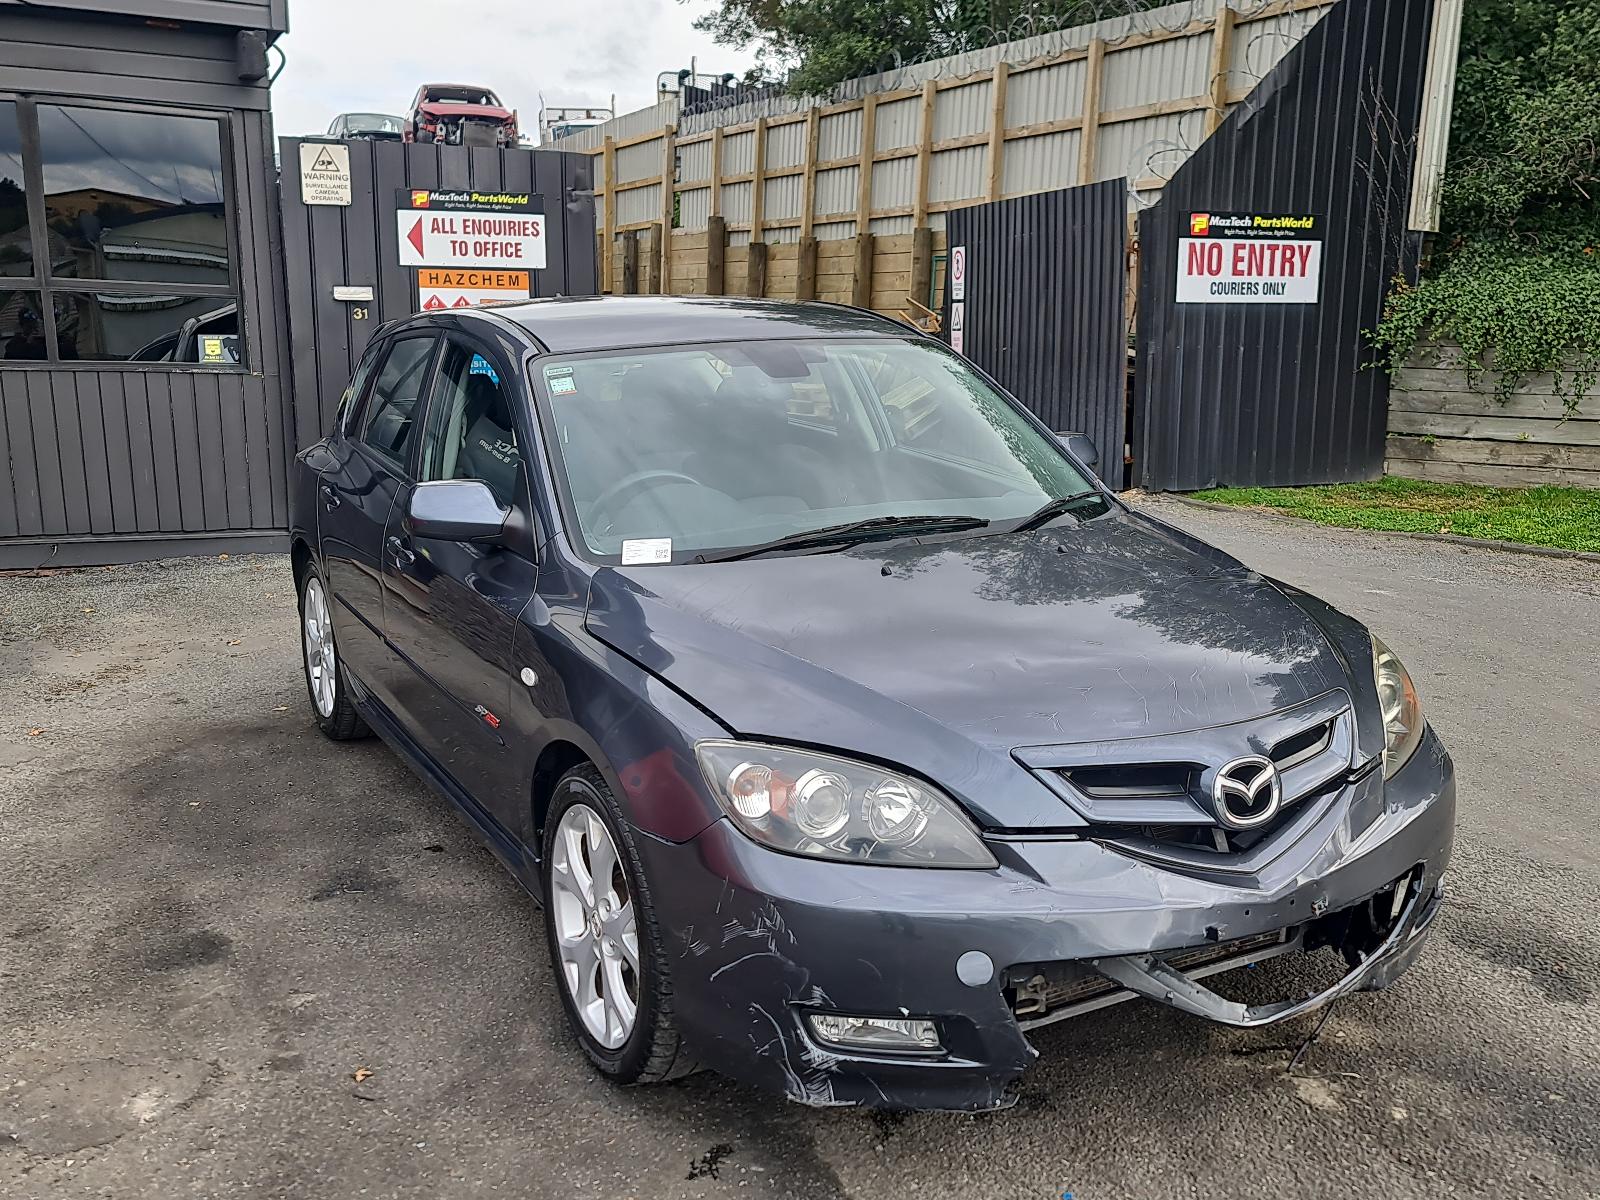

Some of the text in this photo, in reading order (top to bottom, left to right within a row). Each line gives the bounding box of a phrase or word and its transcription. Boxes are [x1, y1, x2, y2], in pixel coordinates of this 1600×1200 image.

[303, 172, 349, 182] WARNING
[430, 192, 529, 204] MazTech PartsWorld
[430, 217, 540, 237] ALL ENQUIRIES
[1209, 215, 1314, 229] MazTech PartsWorld
[450, 240, 523, 258] TO OFFICE
[1187, 242, 1312, 277] NO ENTRY
[429, 273, 520, 286] HAZCHEM
[1210, 281, 1287, 296] COURIERS ONLY
[353, 308, 369, 320] 31
